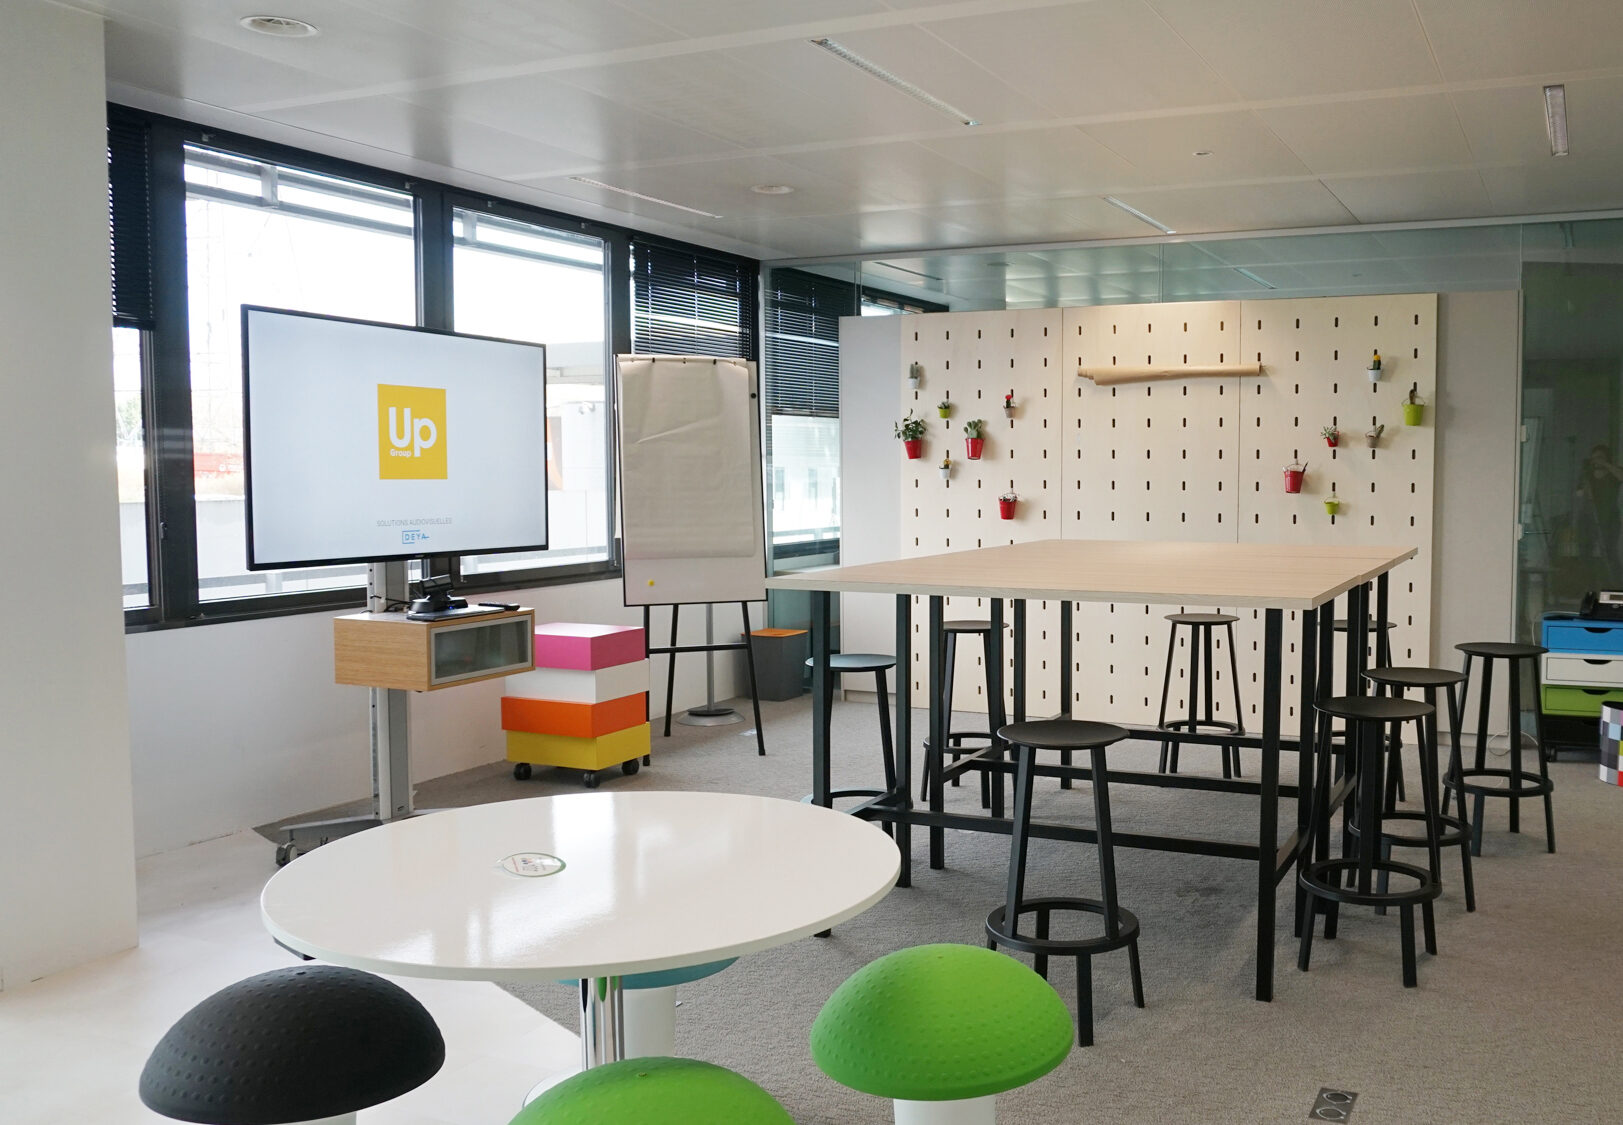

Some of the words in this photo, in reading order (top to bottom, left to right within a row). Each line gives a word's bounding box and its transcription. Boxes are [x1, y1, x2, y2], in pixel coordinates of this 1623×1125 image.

[388, 406, 437, 457] Up
[390, 448, 412, 458] Group
[376, 519, 408, 527] SOLUTIONS
